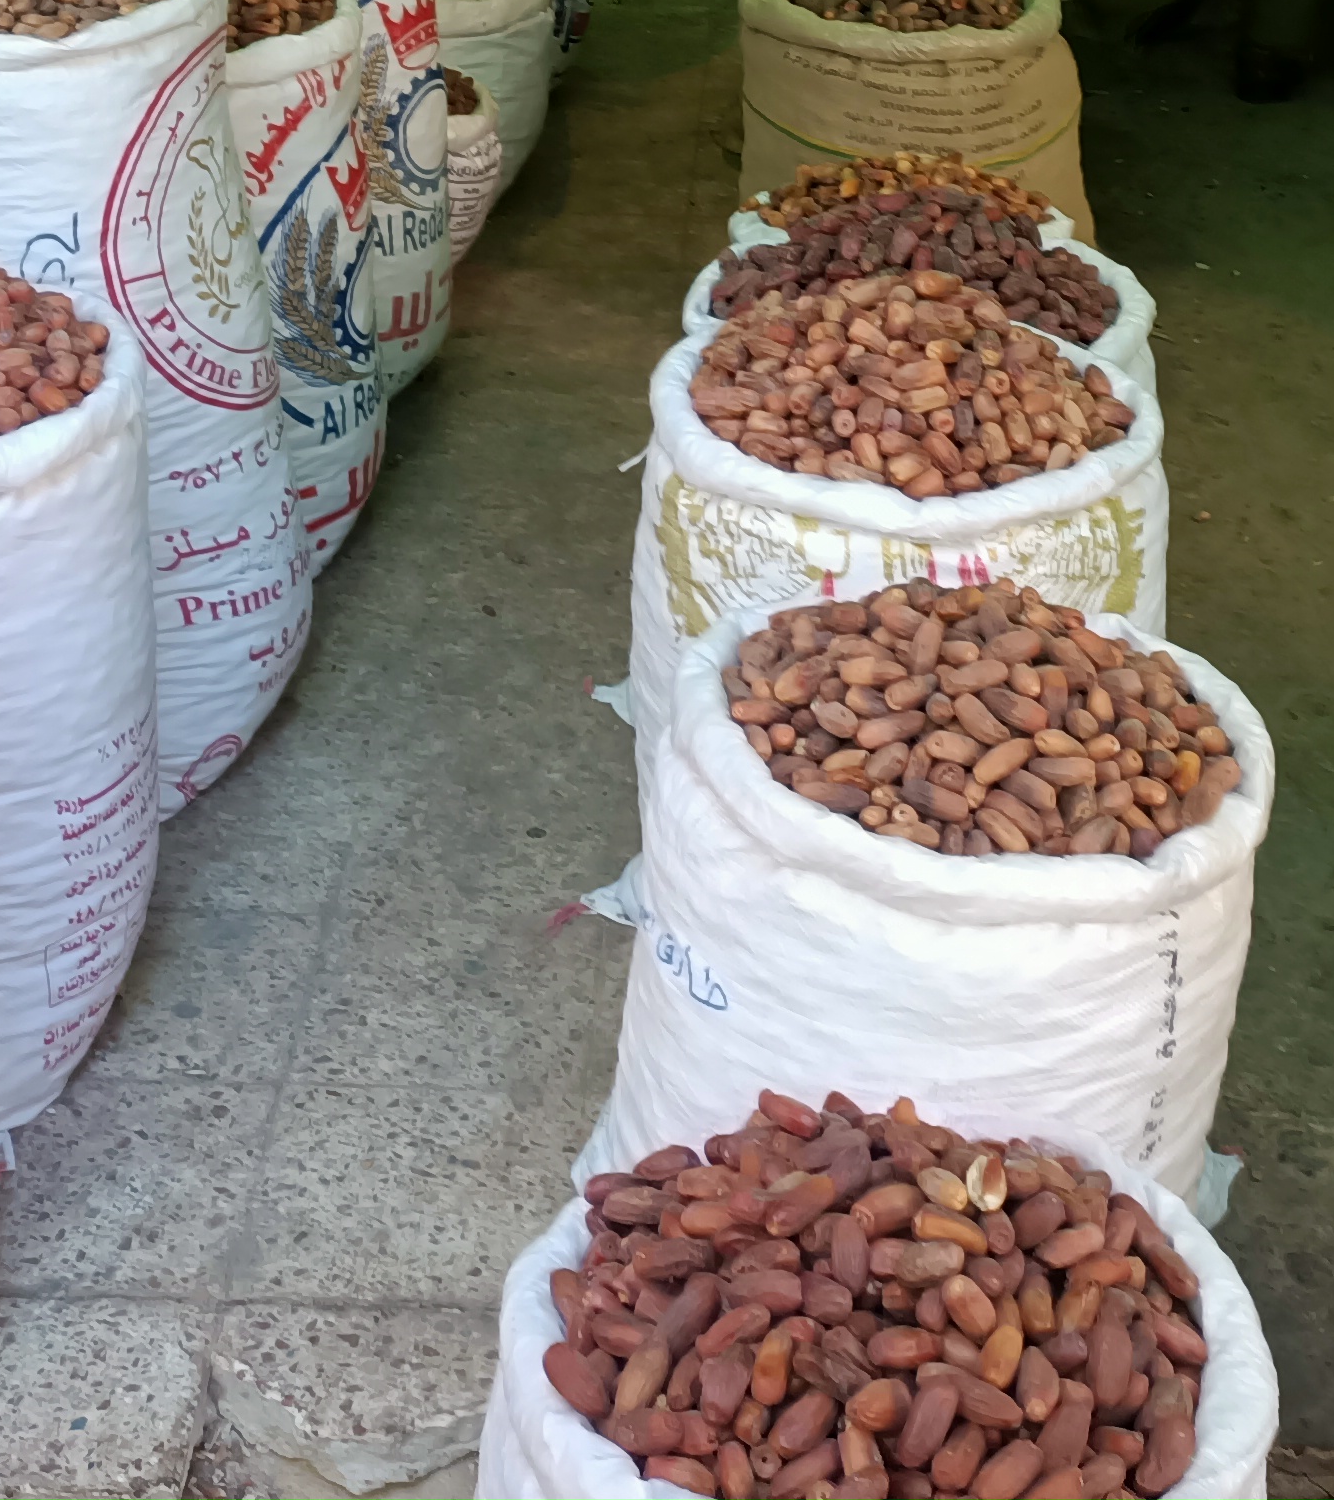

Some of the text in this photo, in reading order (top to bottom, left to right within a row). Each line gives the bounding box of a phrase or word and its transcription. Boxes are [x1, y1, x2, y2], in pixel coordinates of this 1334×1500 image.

[144, 307, 279, 389] Prime Flo
[321, 378, 384, 444] Al Red
[155, 524, 250, 573] ميلز
[177, 548, 312, 627] Prime Flo
[656, 932, 729, 1011] طارق
